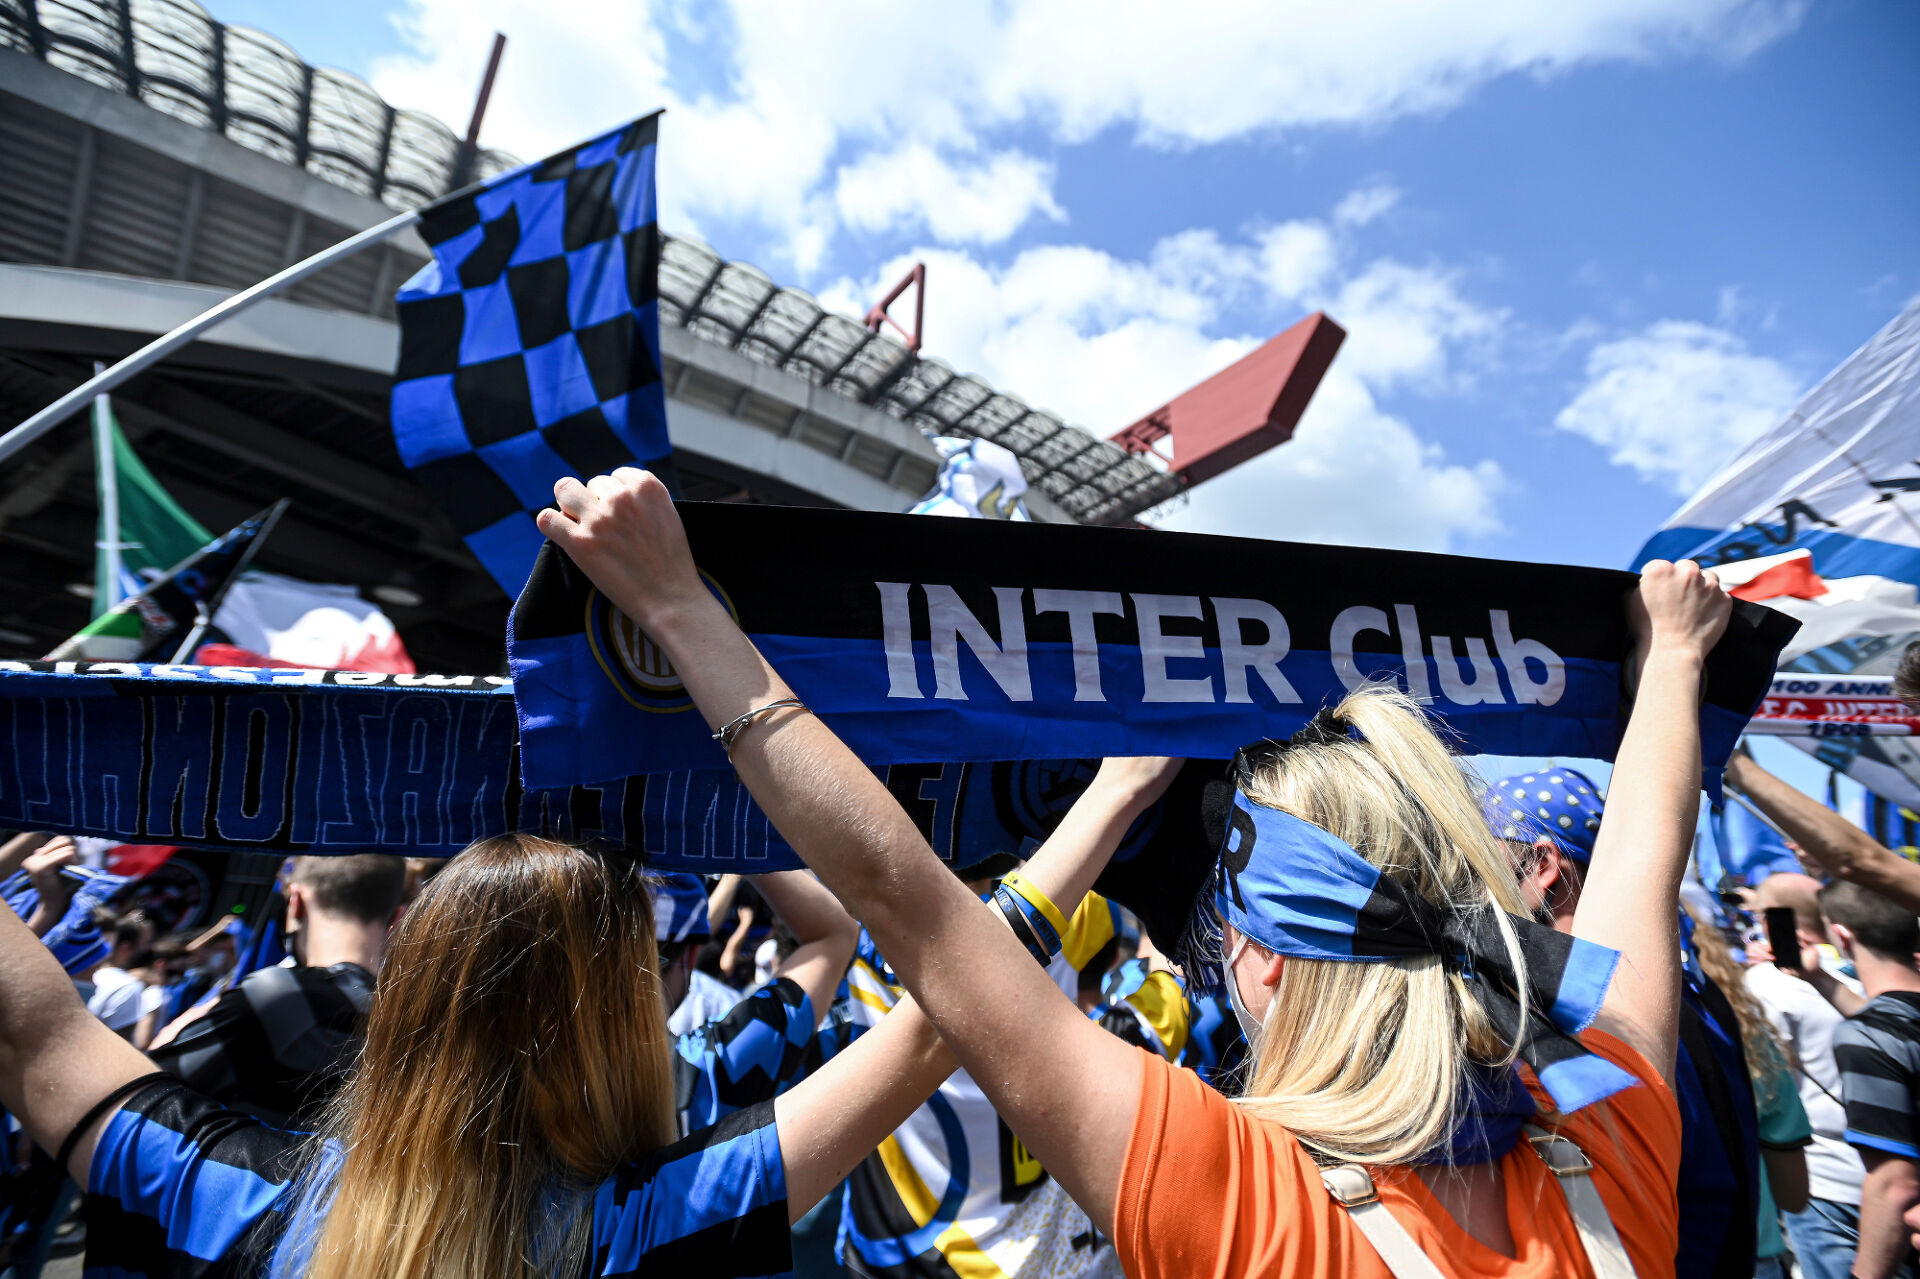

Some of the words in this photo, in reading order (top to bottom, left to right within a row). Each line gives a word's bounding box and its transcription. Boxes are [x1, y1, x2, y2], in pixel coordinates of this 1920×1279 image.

[874, 581, 1304, 704] INTER
[1329, 603, 1566, 706] Club
[1773, 680, 1821, 694] 100
